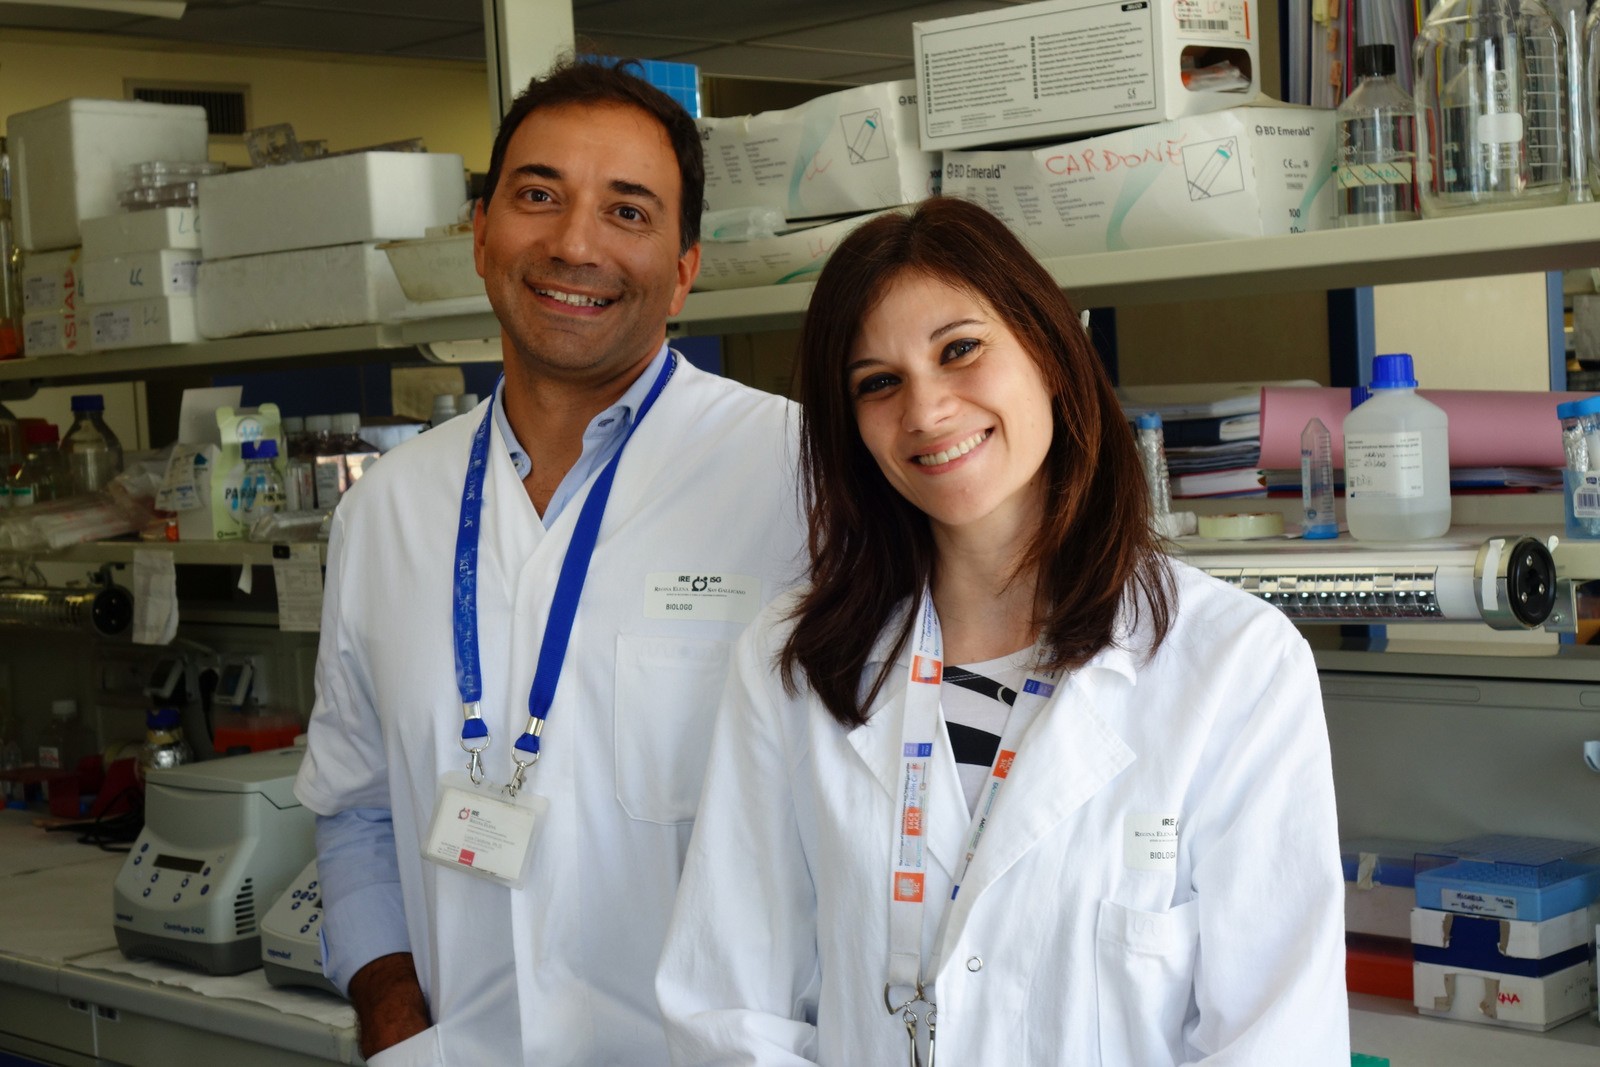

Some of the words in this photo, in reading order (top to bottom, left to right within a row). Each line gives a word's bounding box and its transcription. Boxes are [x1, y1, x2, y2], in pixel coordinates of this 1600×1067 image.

[1264, 126, 1276, 136] BD
[954, 165, 965, 178] BD
[1288, 208, 1301, 218] 100
[678, 575, 691, 583] IRE
[665, 603, 693, 611] BIOLOGO
[1161, 818, 1175, 826] IRE
[1149, 851, 1176, 859] BIOLOG
